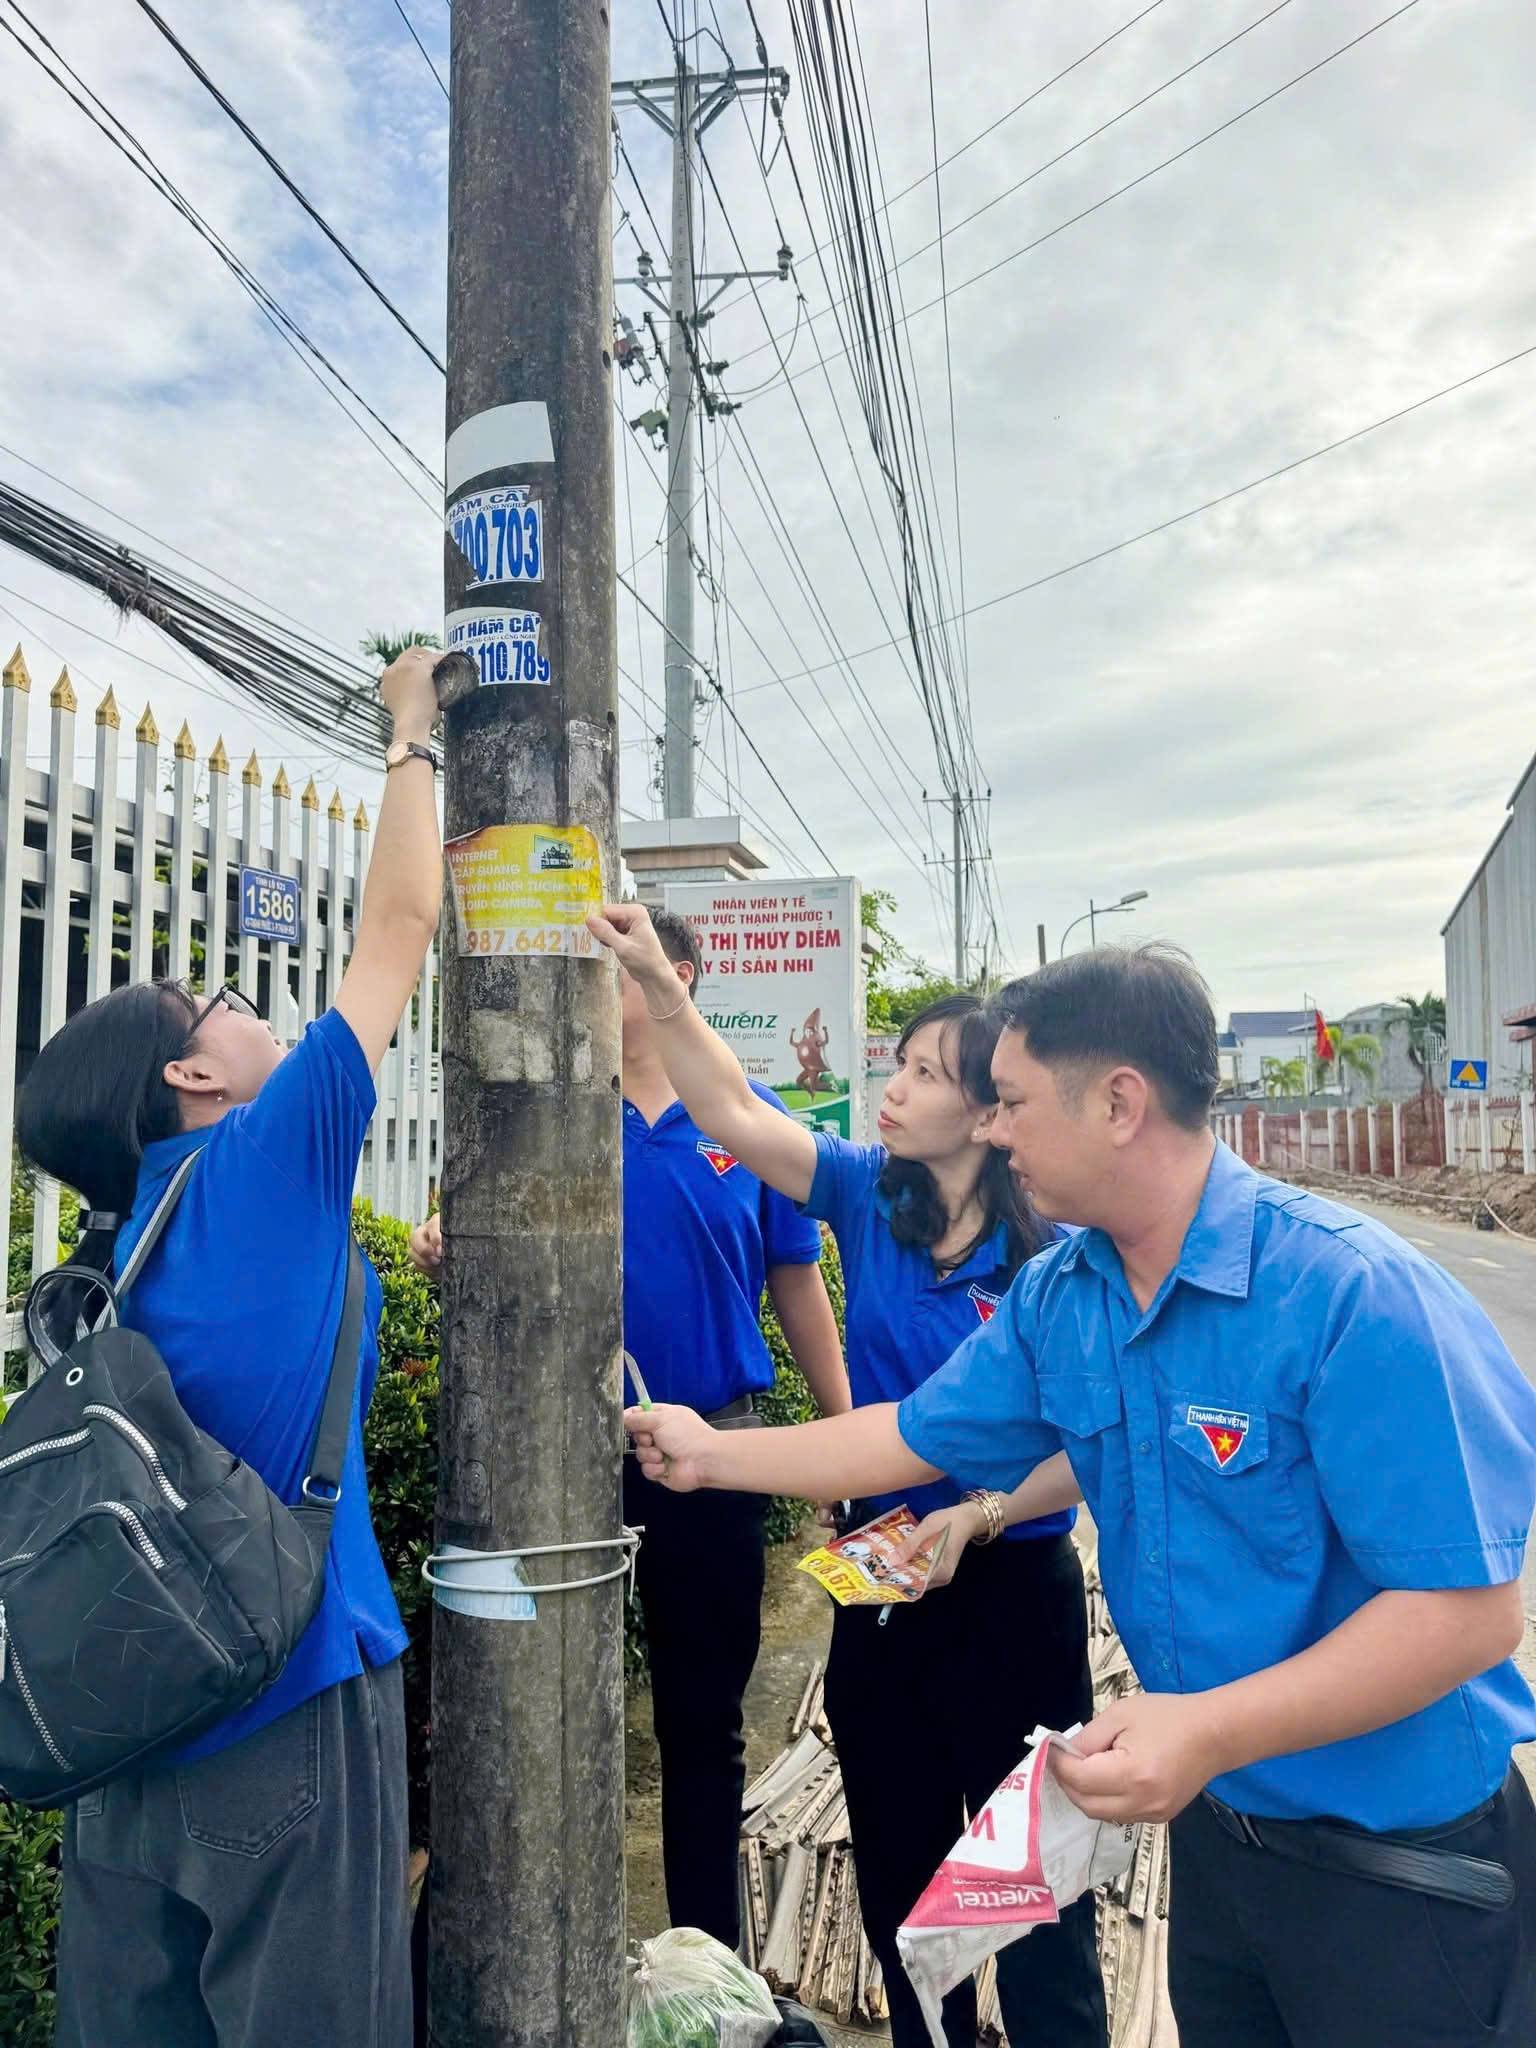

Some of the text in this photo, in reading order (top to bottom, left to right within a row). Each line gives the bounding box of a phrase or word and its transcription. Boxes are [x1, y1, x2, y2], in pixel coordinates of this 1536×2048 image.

[247, 885, 294, 923] 1586
[750, 896, 777, 909] VIÊN
[781, 897, 788, 908] Y
[792, 895, 806, 908] TẾ
[686, 909, 833, 927] KHU VỰC THẠNH PHƯỚC 1
[709, 932, 738, 955] THỊ
[704, 960, 713, 974] Y
[719, 957, 736, 974] SĨ
[783, 958, 814, 972] NHI
[1191, 1410, 1215, 1423] THANH
[996, 1772, 1028, 1795] SIÊ
